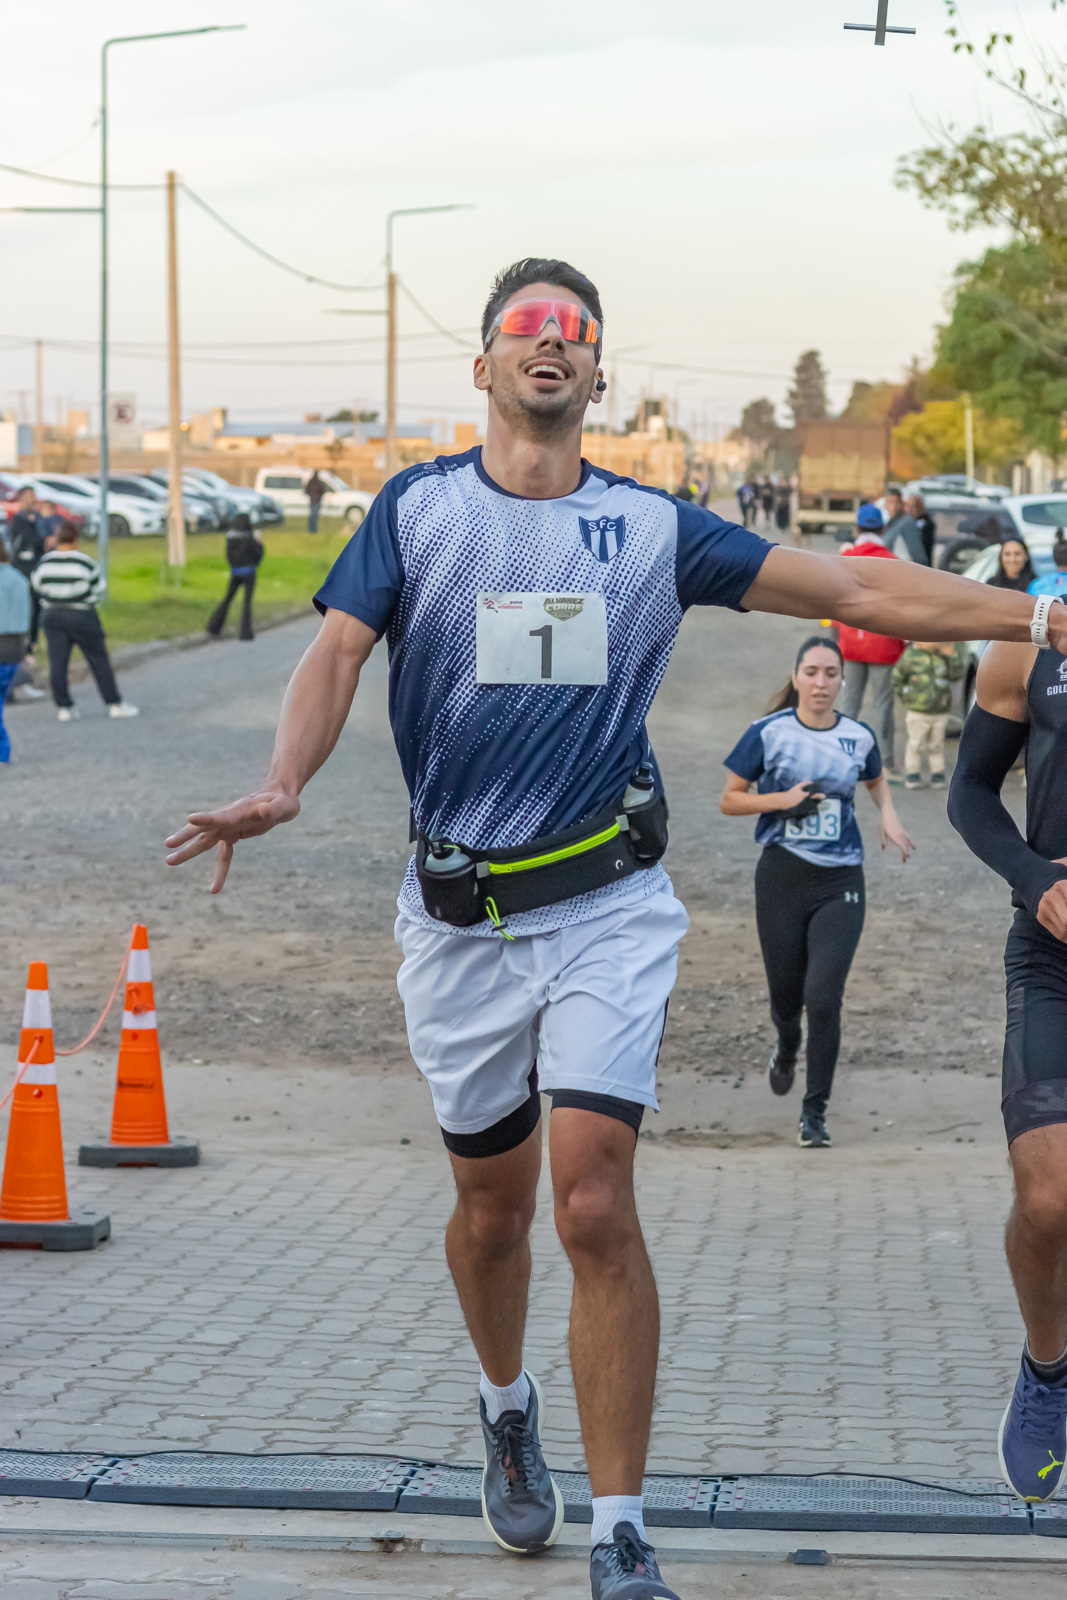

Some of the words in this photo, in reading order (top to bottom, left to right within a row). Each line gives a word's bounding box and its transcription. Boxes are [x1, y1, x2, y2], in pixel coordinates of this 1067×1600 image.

[588, 519, 617, 531] SFC
[545, 603, 584, 611] CORRE
[529, 625, 553, 679] 1
